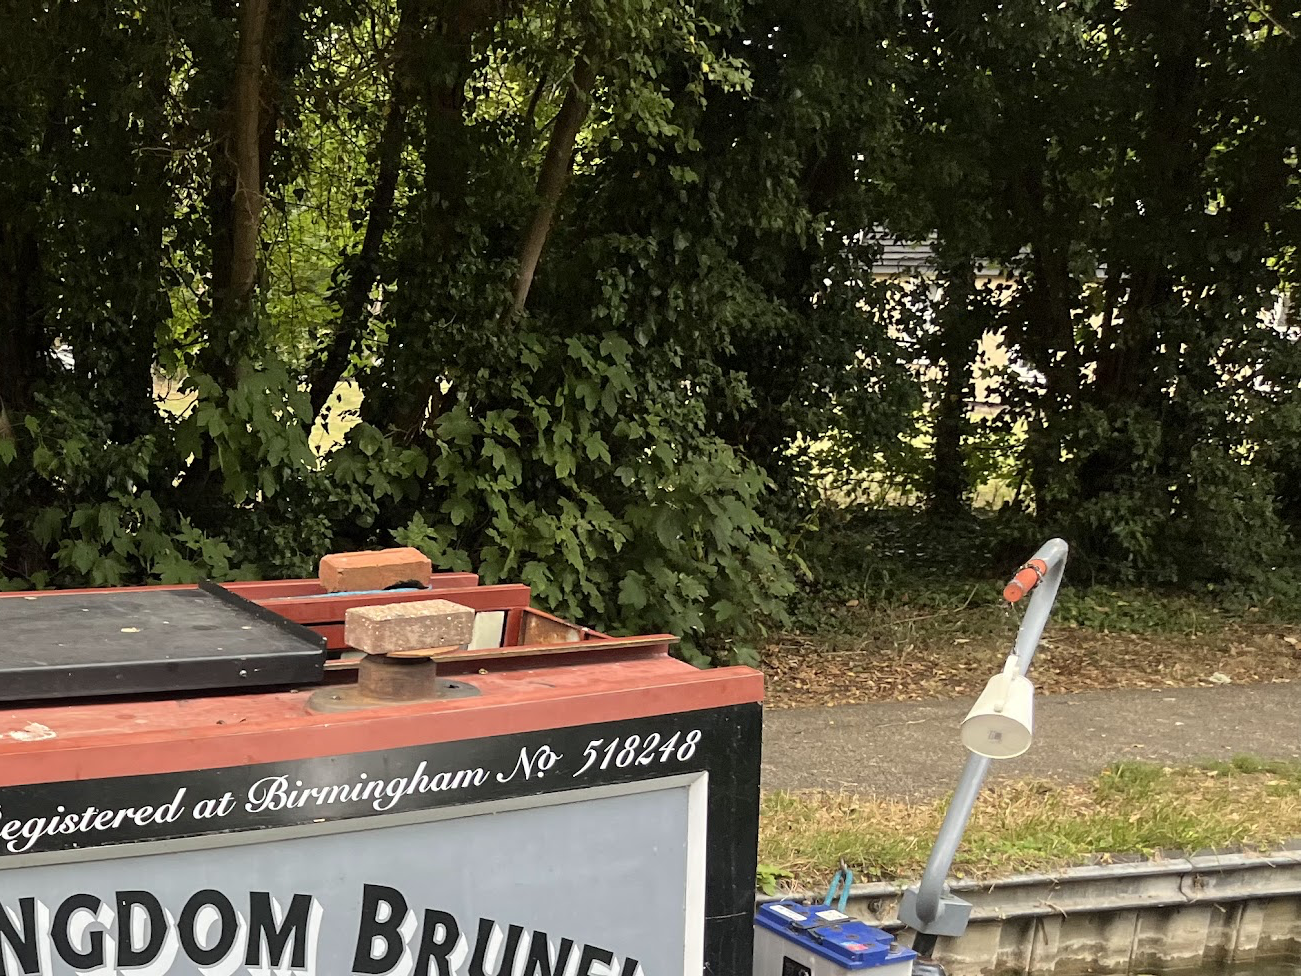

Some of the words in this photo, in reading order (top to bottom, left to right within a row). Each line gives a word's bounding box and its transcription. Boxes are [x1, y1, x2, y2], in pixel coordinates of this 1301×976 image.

[192, 788, 234, 818] at
[244, 765, 490, 814] Birmingham
[572, 729, 702, 777] 518248
